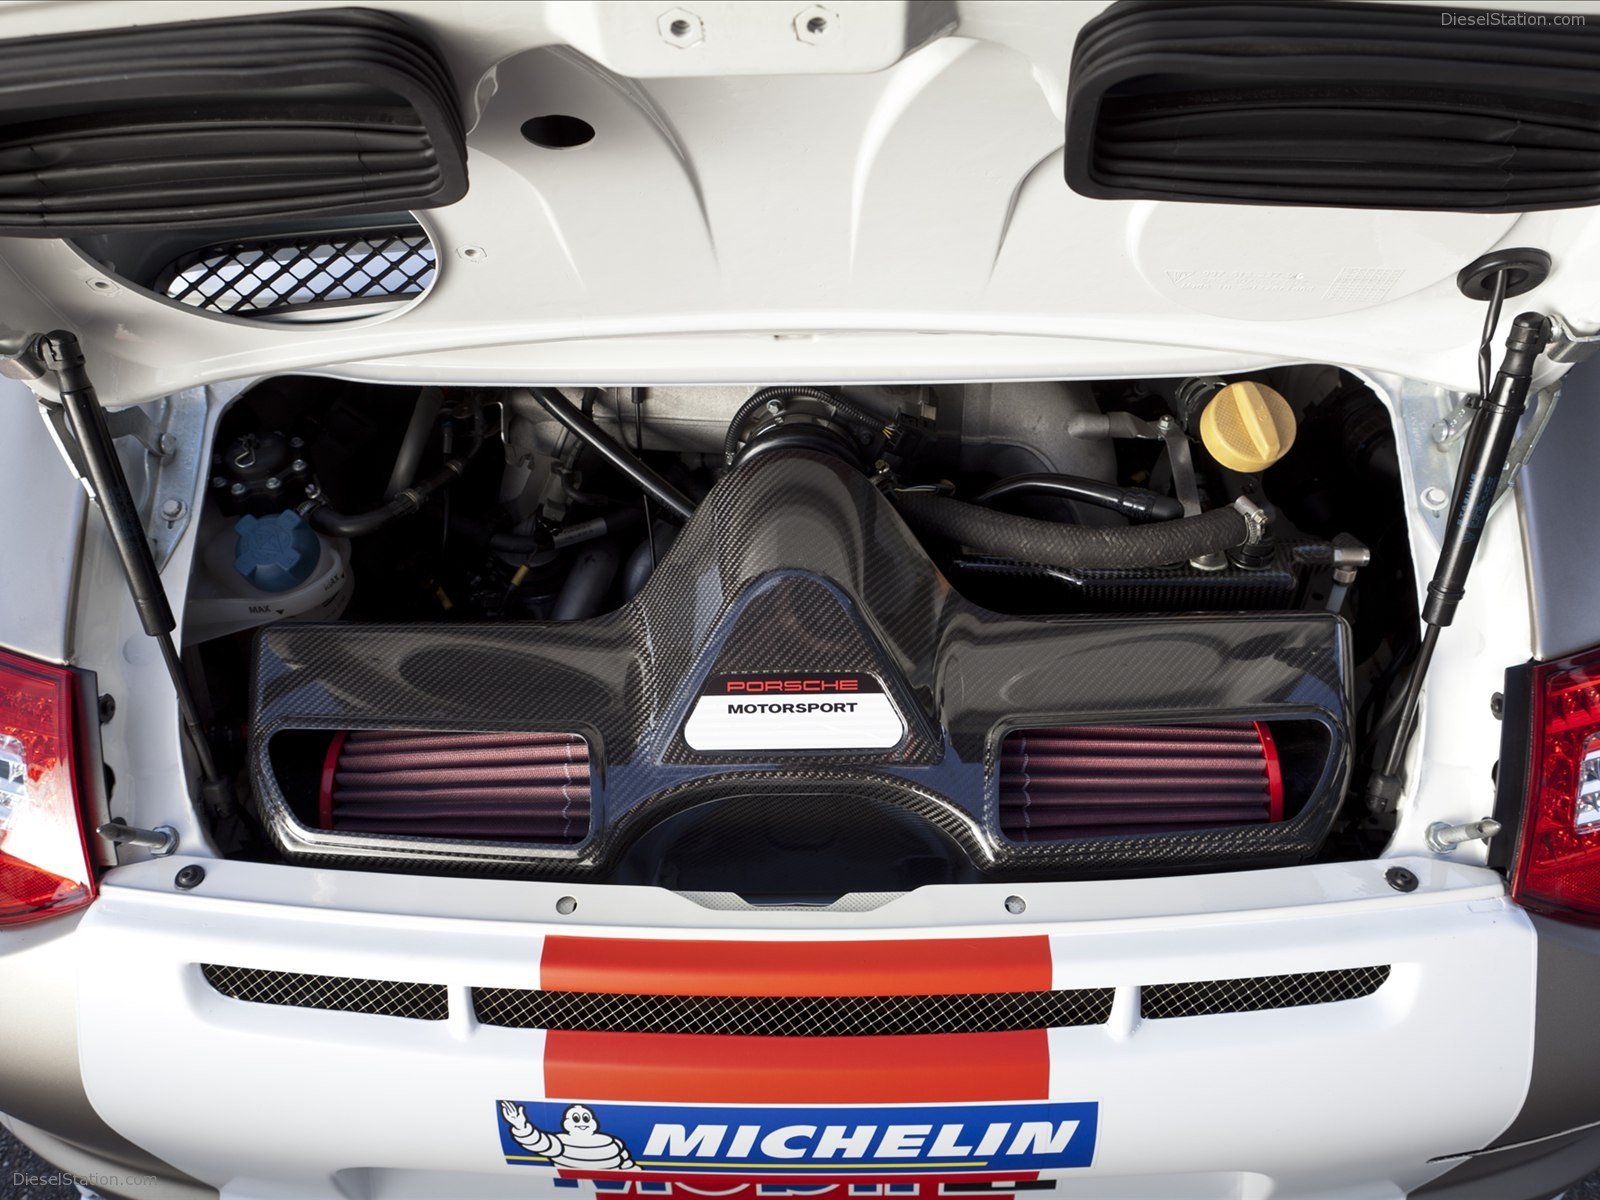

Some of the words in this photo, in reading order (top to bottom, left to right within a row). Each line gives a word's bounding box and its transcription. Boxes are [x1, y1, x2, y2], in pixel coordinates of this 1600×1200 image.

[248, 605, 272, 614] MAX
[727, 680, 859, 692] PORSCHE
[727, 702, 858, 714] MOTORSPORT
[643, 1120, 1081, 1158] MICHELIN
